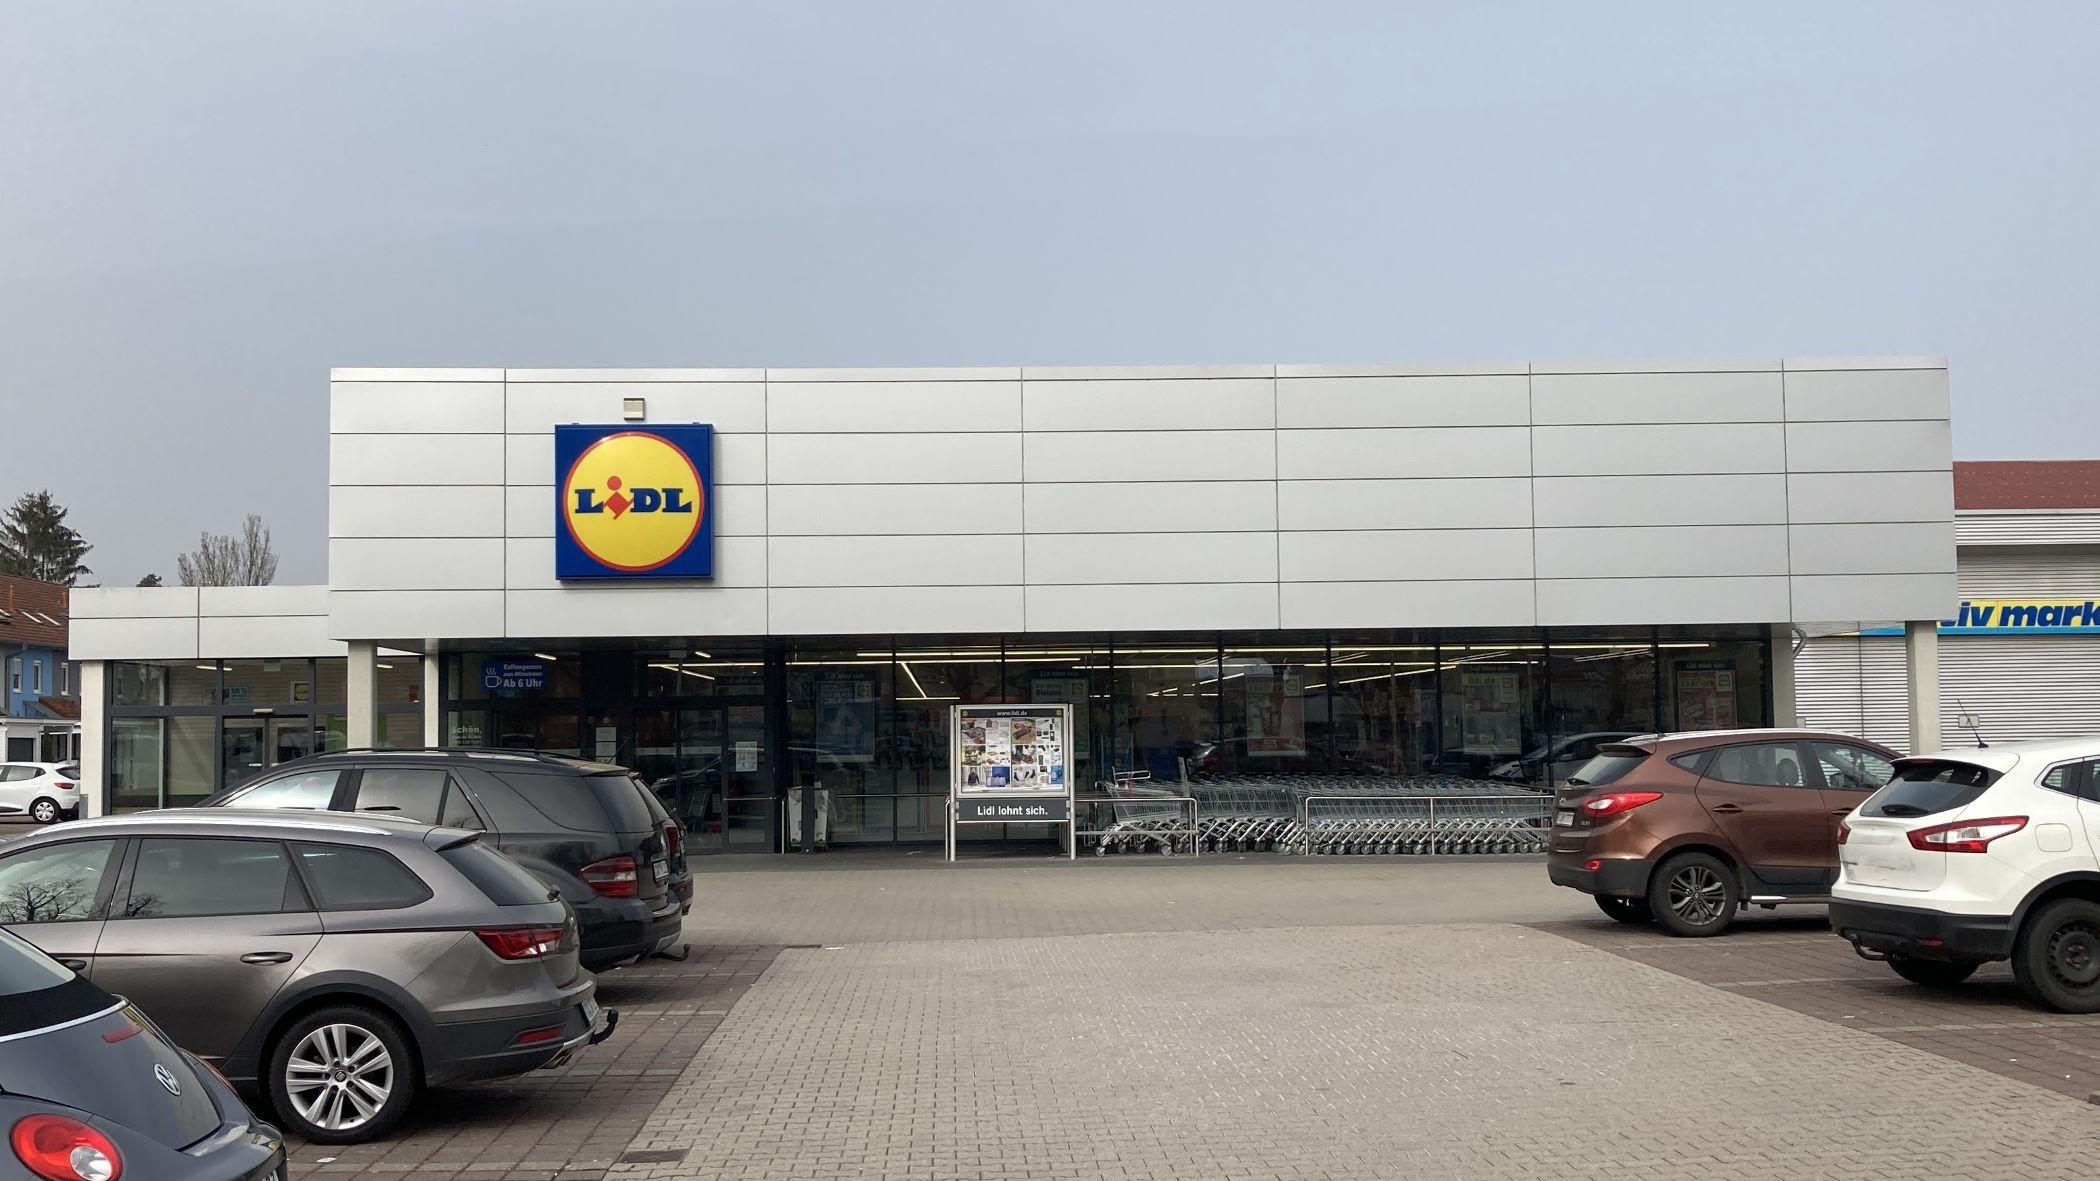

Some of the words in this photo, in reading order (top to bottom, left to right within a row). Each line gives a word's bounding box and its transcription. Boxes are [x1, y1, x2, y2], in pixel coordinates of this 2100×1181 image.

[1941, 601, 1996, 627] iv
[503, 678, 516, 688] Ab
[517, 678, 524, 688] 6
[525, 678, 543, 688] Uhr
[977, 805, 995, 816] Lidl
[998, 805, 1023, 816] lohnt
[1025, 805, 1048, 816] sich.
